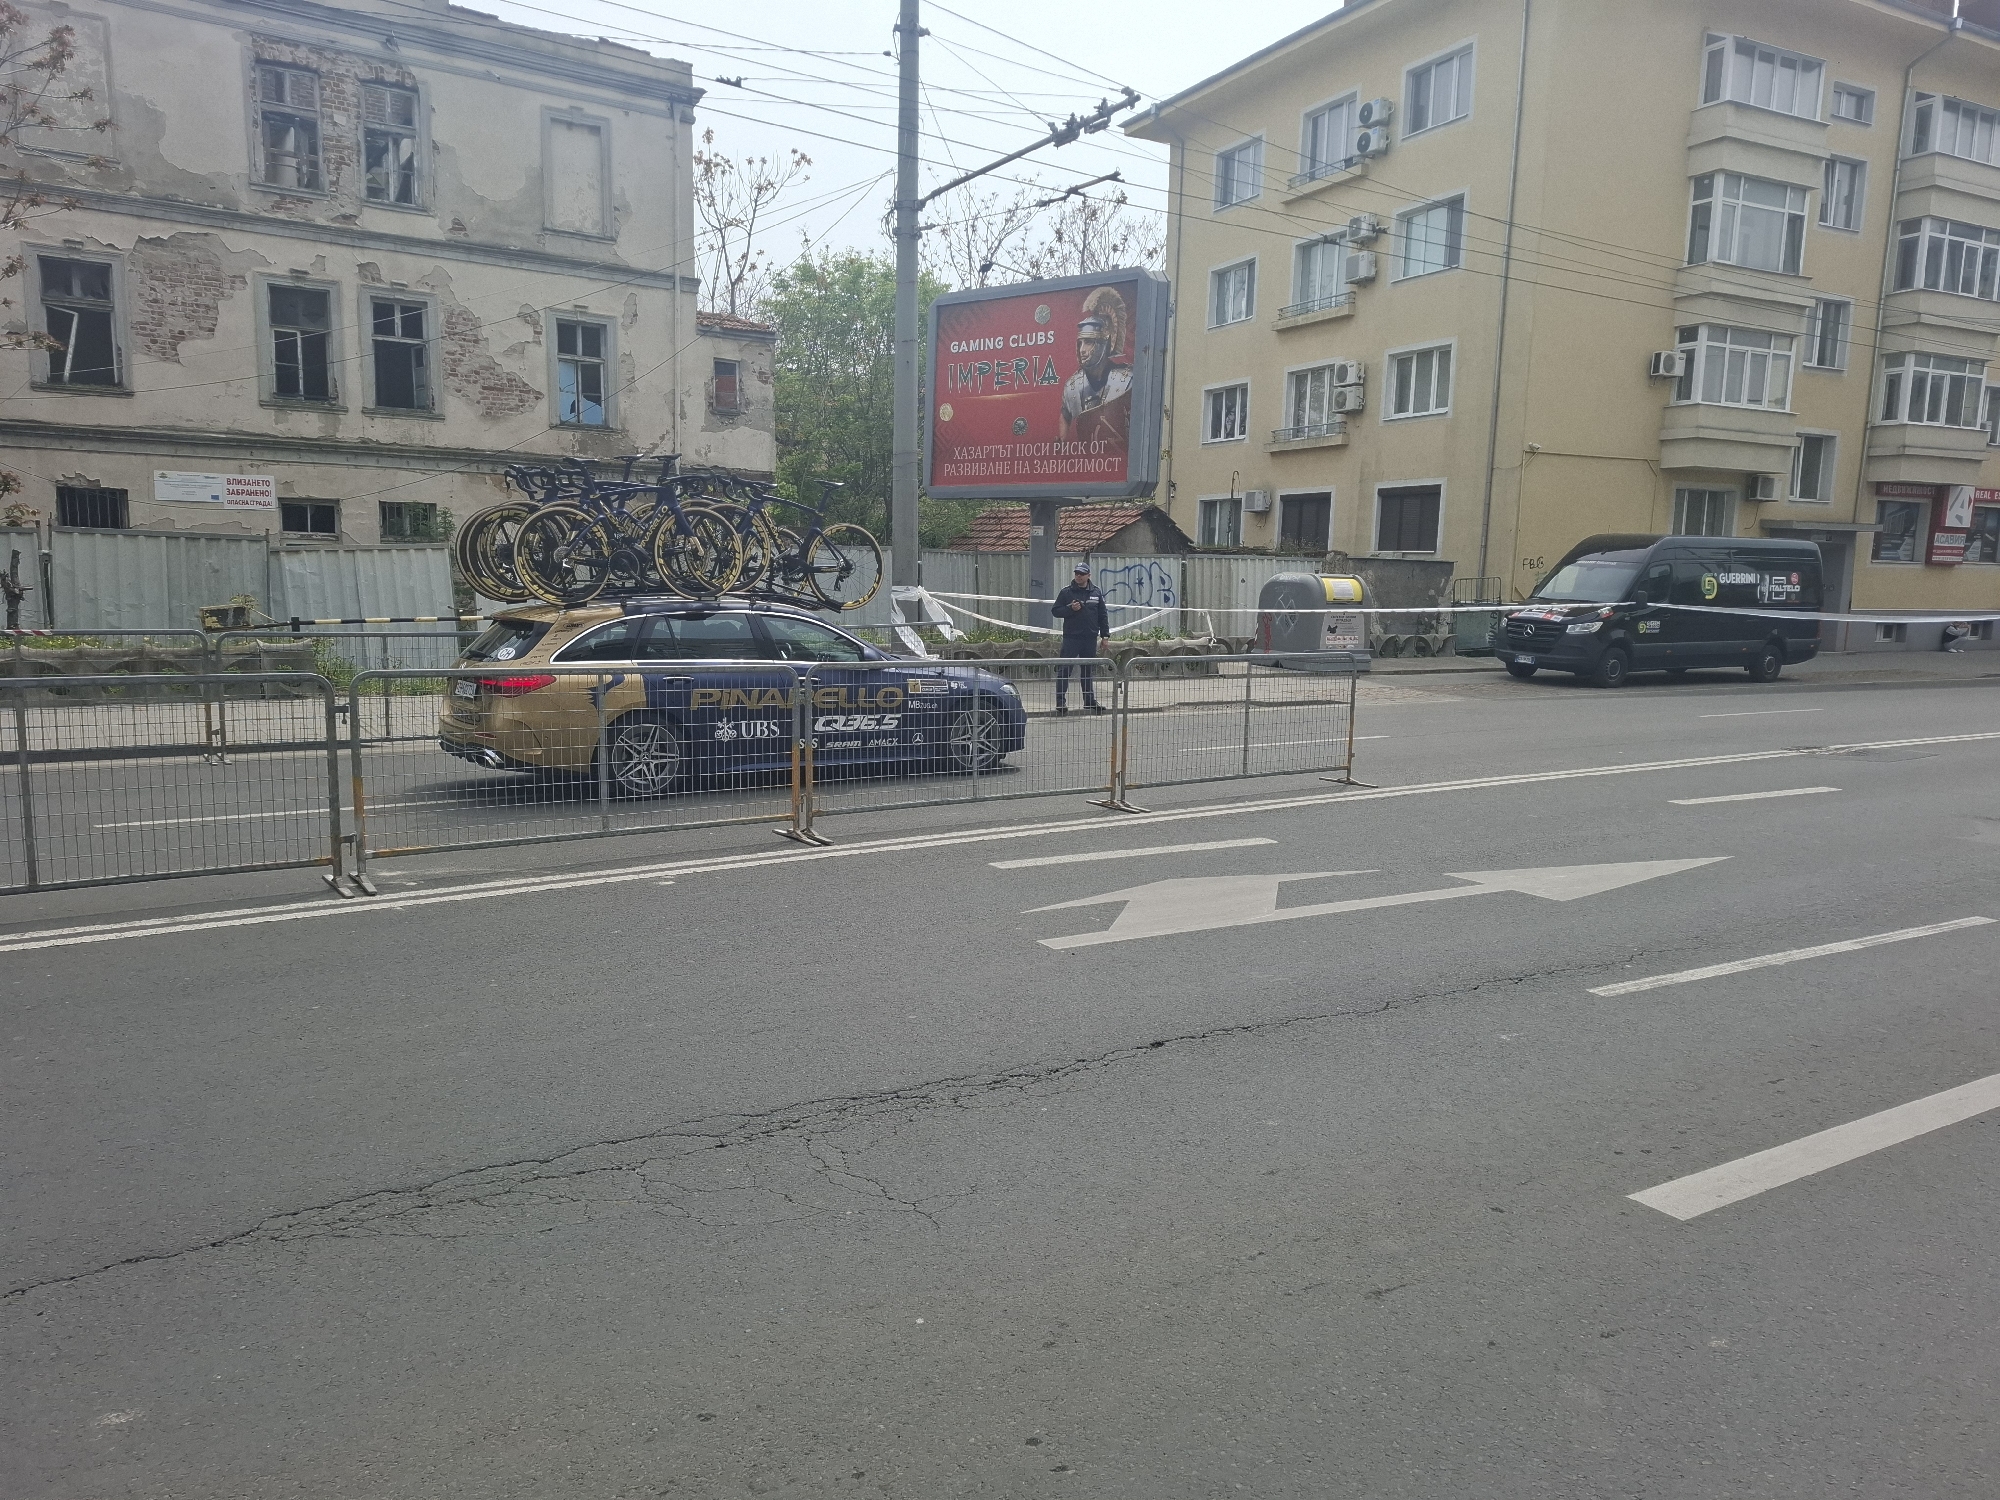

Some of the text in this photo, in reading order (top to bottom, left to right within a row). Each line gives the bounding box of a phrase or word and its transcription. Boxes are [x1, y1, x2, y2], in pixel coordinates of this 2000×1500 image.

[950, 331, 1055, 353] GAMING CLUBS
[948, 355, 1061, 394] IMPERIA
[953, 444, 1014, 460] ХАЗАРТЪТ
[1053, 441, 1086, 456] РИСК
[1090, 440, 1108, 454] ОТ
[944, 457, 1122, 477] РАЗВИВАНЕ НА ЗАВИСИМОСТ
[226, 477, 271, 487] ВЛИЗАНЕТО
[226, 488, 272, 498] ЗАБРАНЕНО!
[1975, 490, 1991, 500] REAL
[1719, 573, 1756, 584] GUERRINI
[741, 720, 780, 738] UBS
[826, 739, 862, 748] SRAM
[868, 737, 899, 746] AMACX
